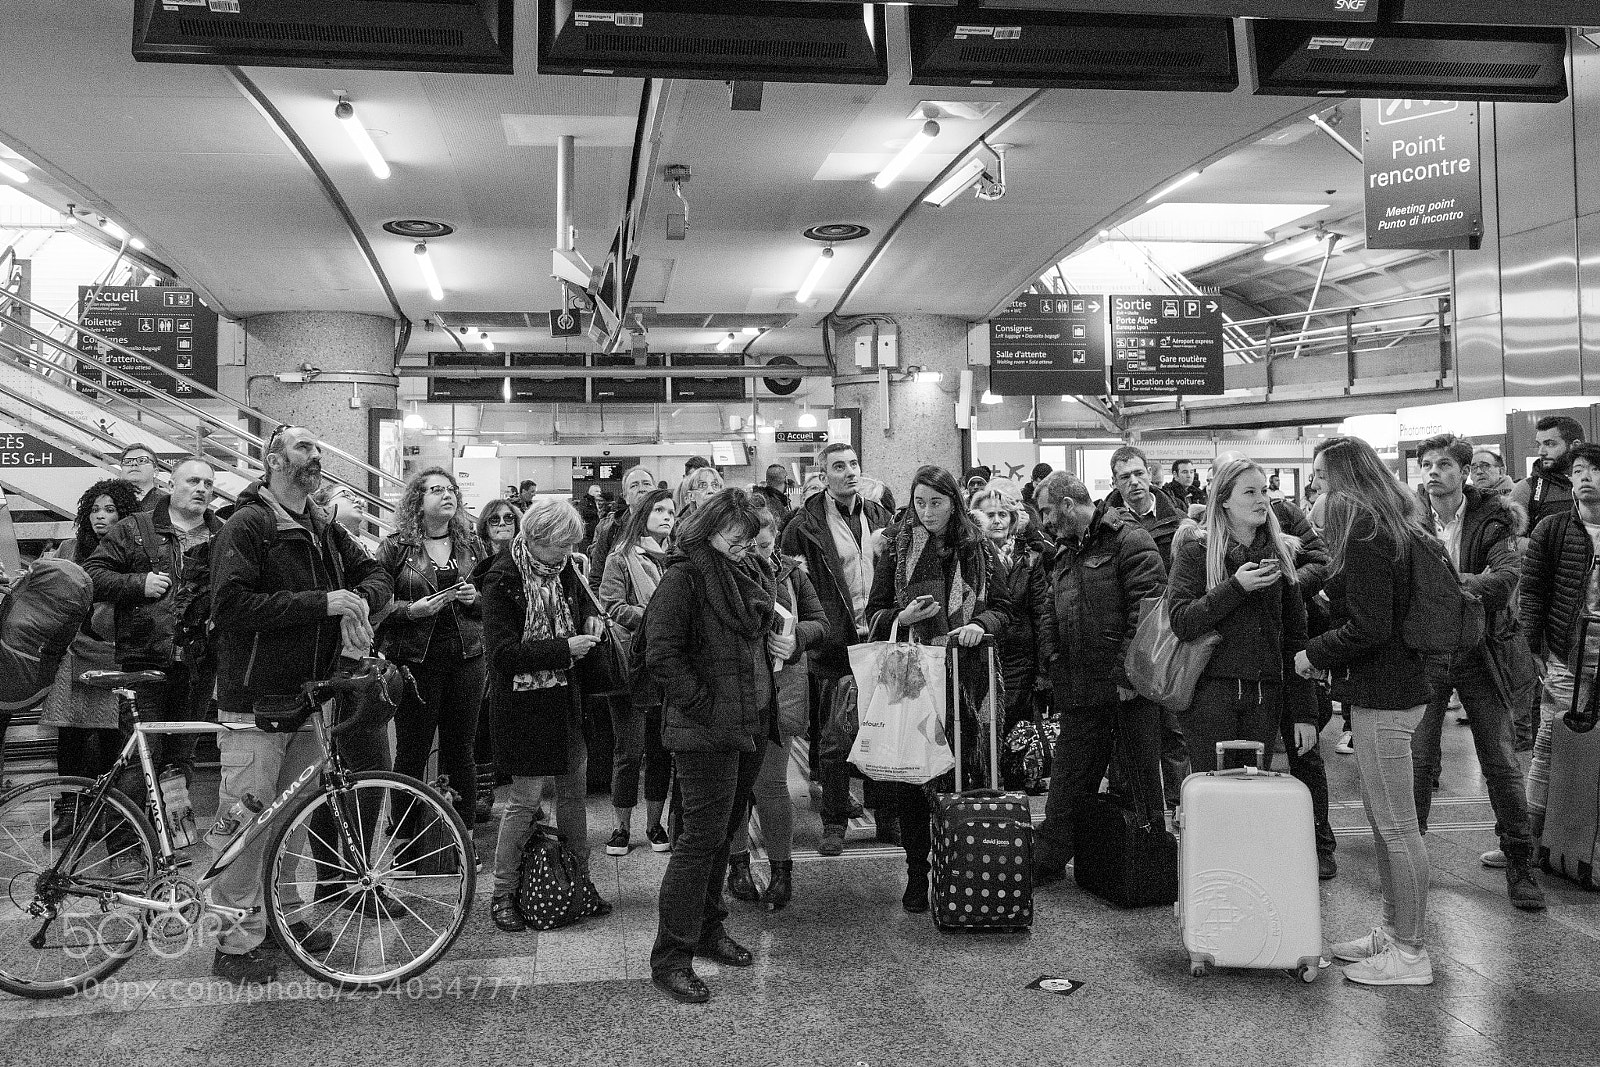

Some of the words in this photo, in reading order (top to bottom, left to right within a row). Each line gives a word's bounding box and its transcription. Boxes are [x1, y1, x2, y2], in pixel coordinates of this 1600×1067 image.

[1334, 0, 1366, 10] SNCF
[1392, 134, 1446, 160] Point
[1370, 158, 1471, 188] rencontre
[1385, 204, 1426, 218] Meeting
[1427, 198, 1456, 213] point
[1377, 220, 1407, 231] Punto
[1409, 218, 1420, 227] di
[1421, 211, 1464, 225] incontro
[84, 289, 139, 302] Accueil
[1115, 298, 1152, 310] Sortie
[1188, 303, 1197, 316] P
[83, 317, 122, 327] Toilettes
[1116, 316, 1136, 325] Porte
[1137, 317, 1158, 325] Alpes
[995, 324, 1033, 333] Consignes
[1129, 339, 1136, 347] T
[1140, 339, 1146, 347] 3
[1149, 339, 1155, 347] 4
[996, 351, 1014, 359] Salle
[1014, 351, 1047, 359] d'attente
[1159, 354, 1177, 363] Gare
[1178, 354, 1207, 363] routière
[1132, 377, 1164, 386] Location
[1165, 378, 1175, 386] de
[1176, 378, 1205, 386] voitures
[787, 432, 814, 440] Accueil
[1400, 423, 1443, 437] Photomaton
[24, 452, 53, 465] G-H
[258, 765, 315, 824] OLMO
[145, 772, 163, 834] OLMO
[343, 821, 356, 852] OLMO
